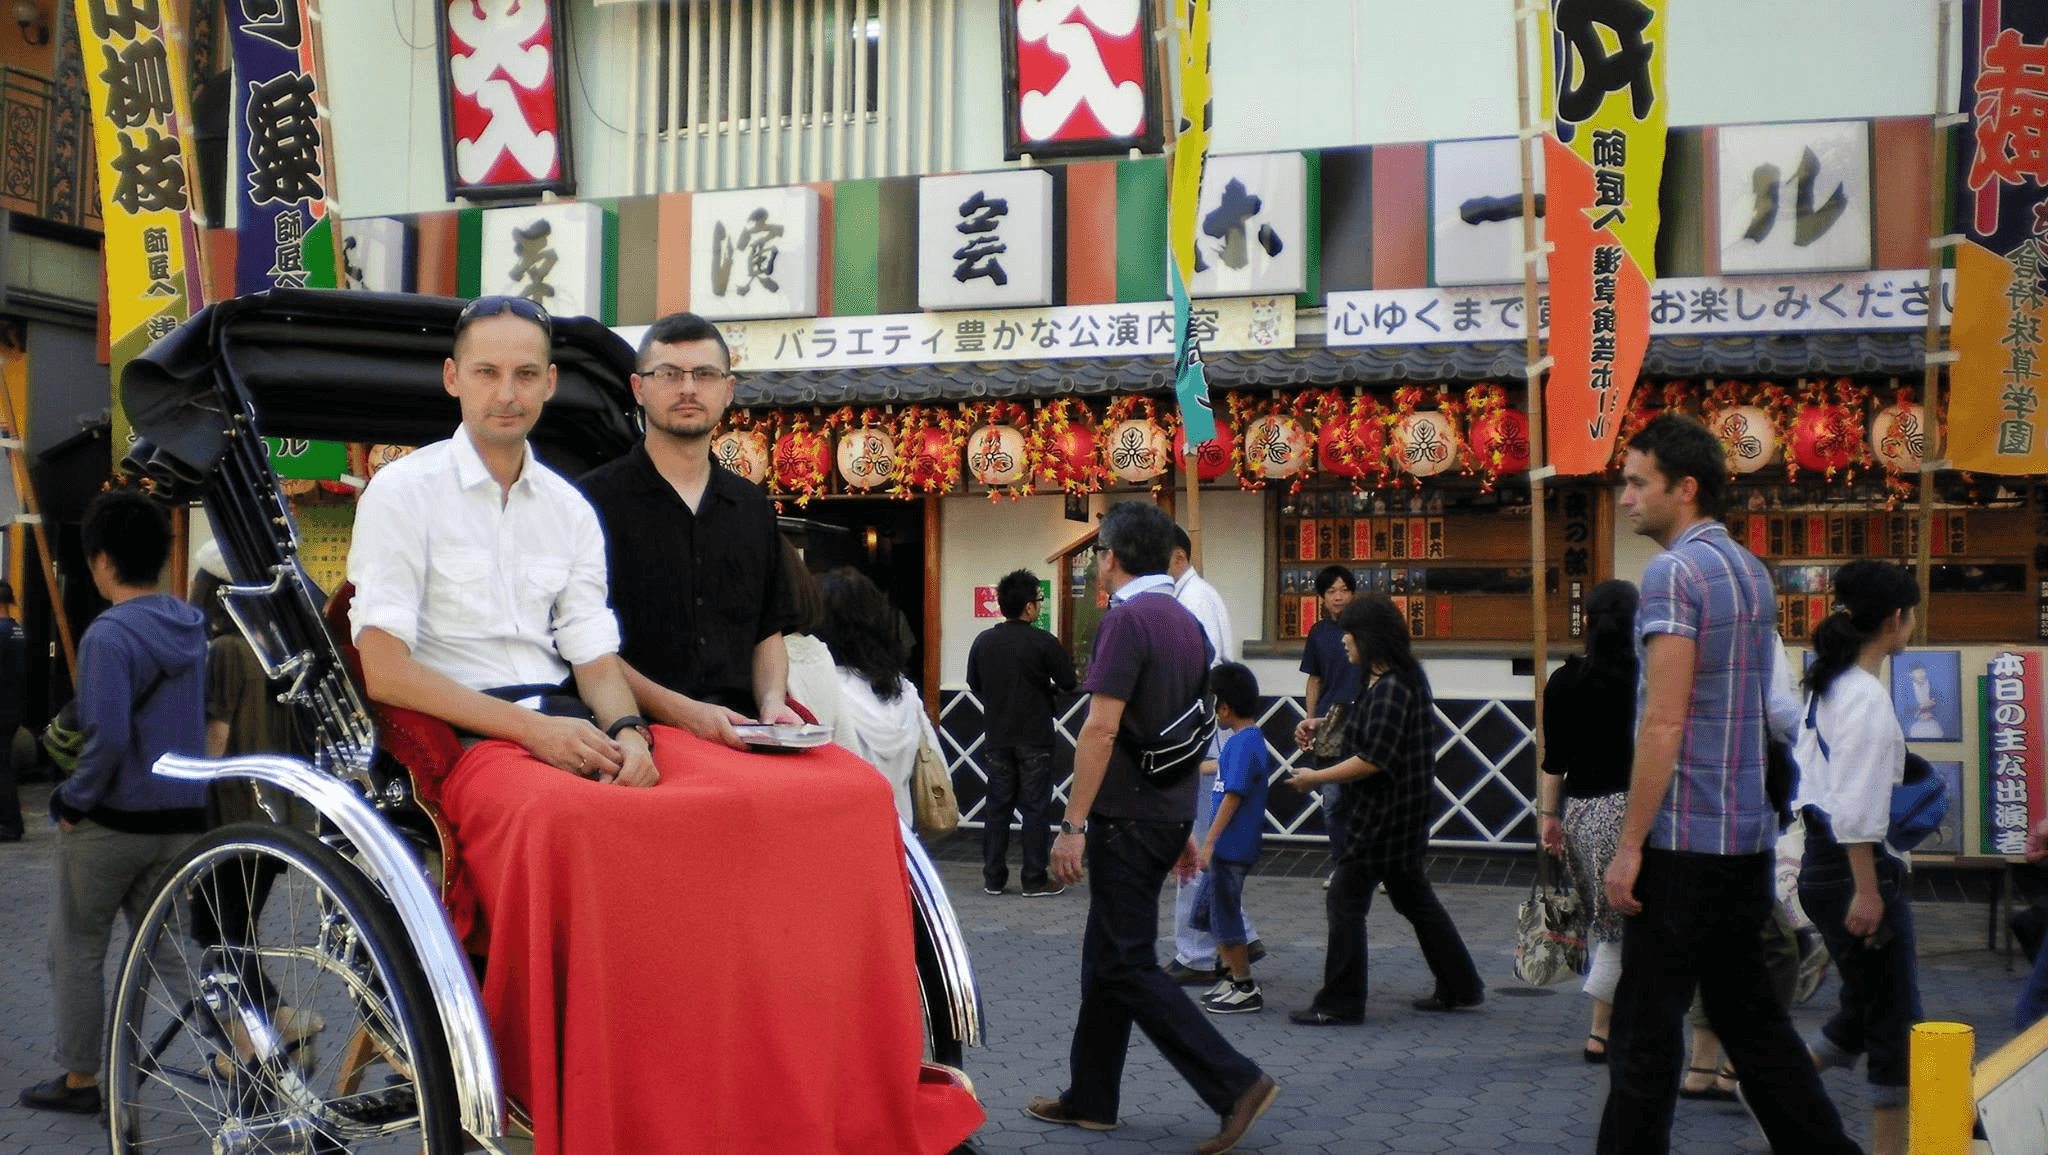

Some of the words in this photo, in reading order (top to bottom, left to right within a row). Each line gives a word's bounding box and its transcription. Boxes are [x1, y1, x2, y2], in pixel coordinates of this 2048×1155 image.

[143, 226, 176, 295] 師匠へ
[773, 308, 1220, 362] バラエティ豊かな公演内容
[1994, 651, 2030, 854] 本日の主な出演者
